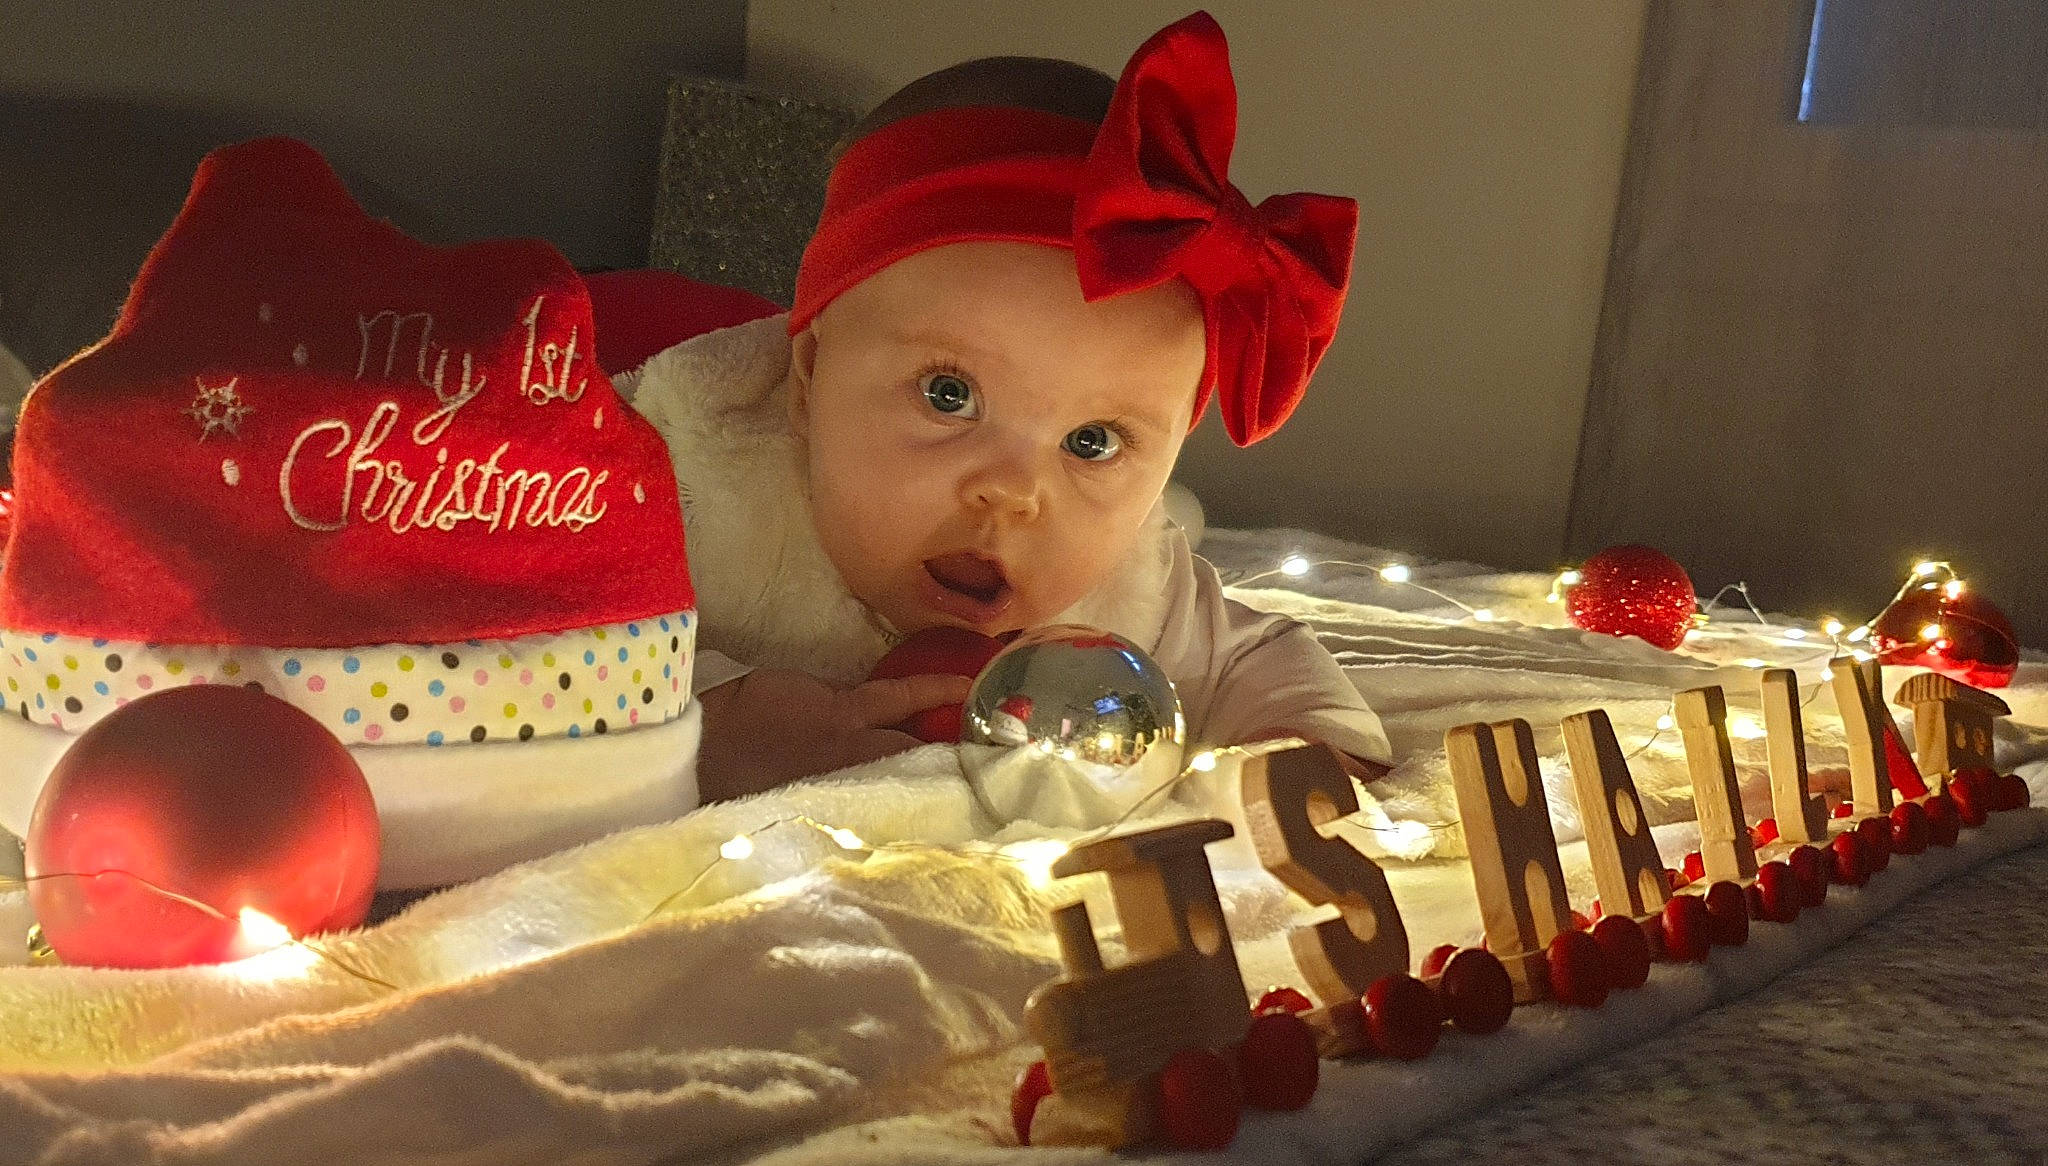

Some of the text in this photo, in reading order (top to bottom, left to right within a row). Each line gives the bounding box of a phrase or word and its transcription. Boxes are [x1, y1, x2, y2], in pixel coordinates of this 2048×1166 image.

[354, 295, 588, 446] My 1st
[279, 400, 609, 534] Christmas
